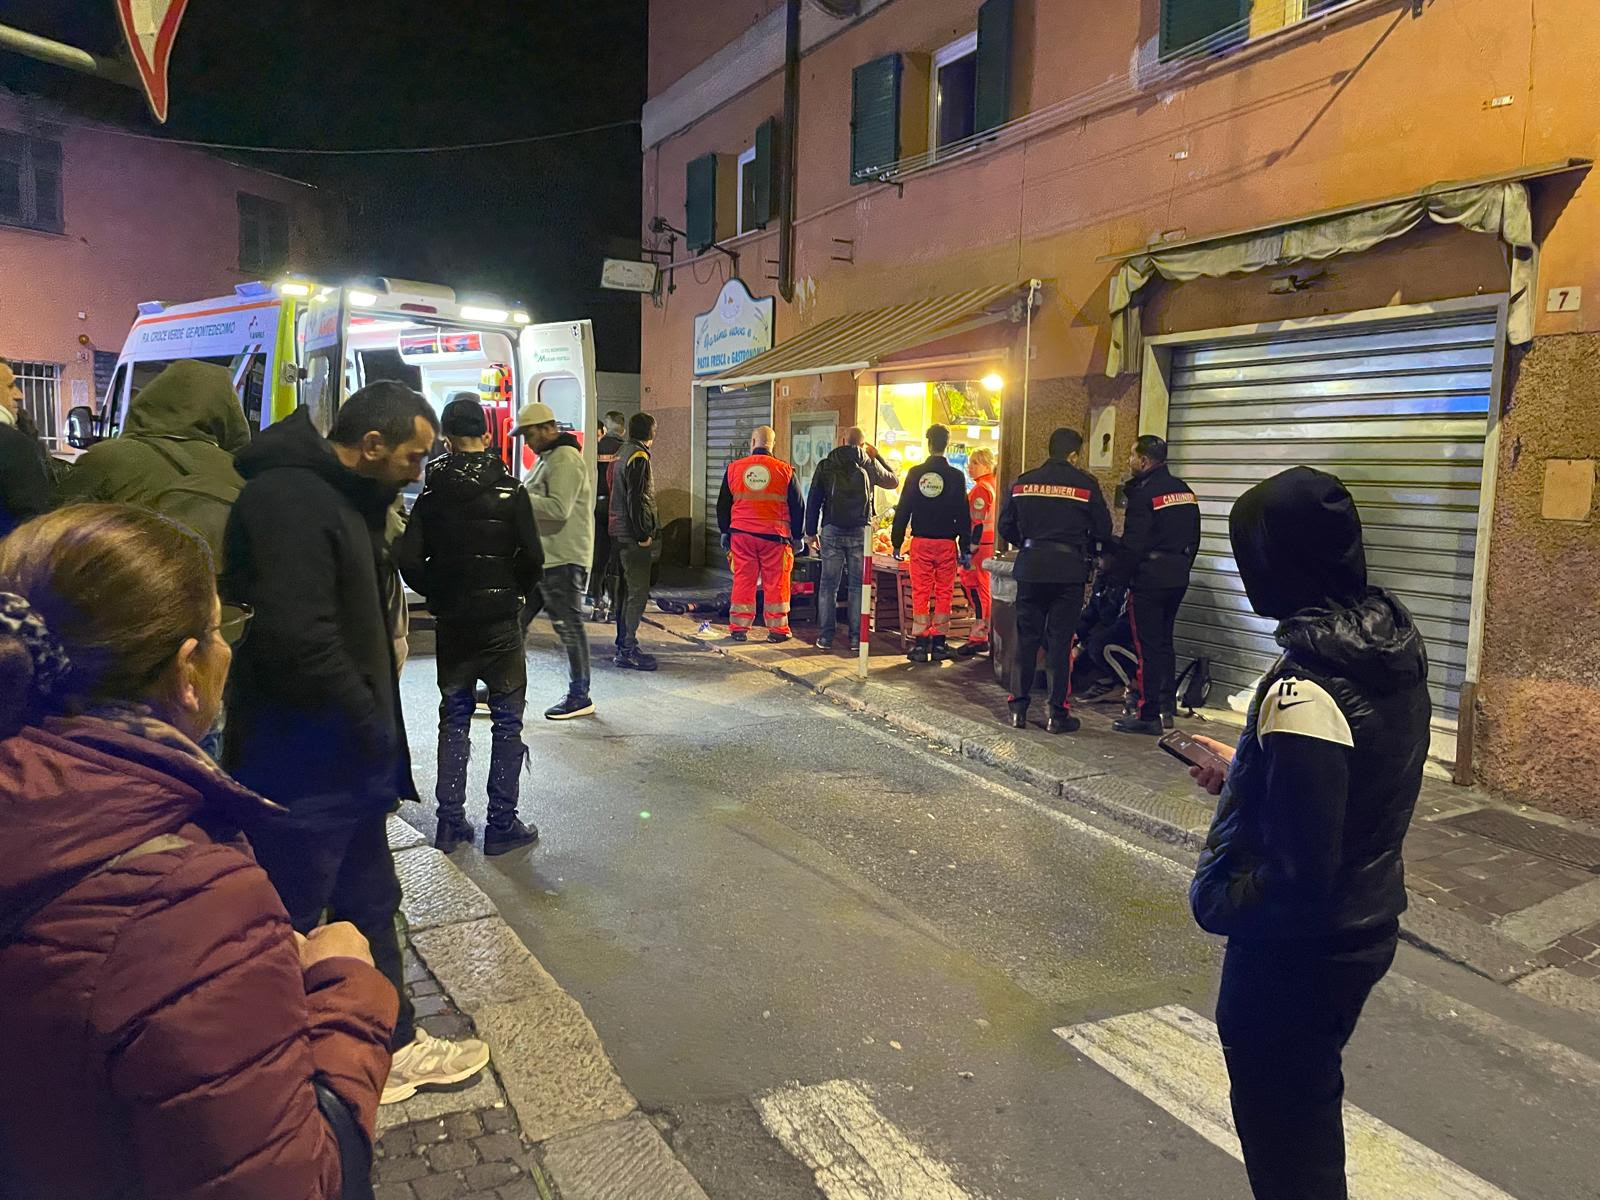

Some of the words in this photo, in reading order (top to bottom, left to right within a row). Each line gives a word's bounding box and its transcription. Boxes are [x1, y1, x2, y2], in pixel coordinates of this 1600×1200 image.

[1559, 291, 1569, 309] 7
[1023, 484, 1076, 497] CARABINIERI
[1163, 492, 1196, 505] CARABINIER
[1279, 681, 1298, 696] IT.
